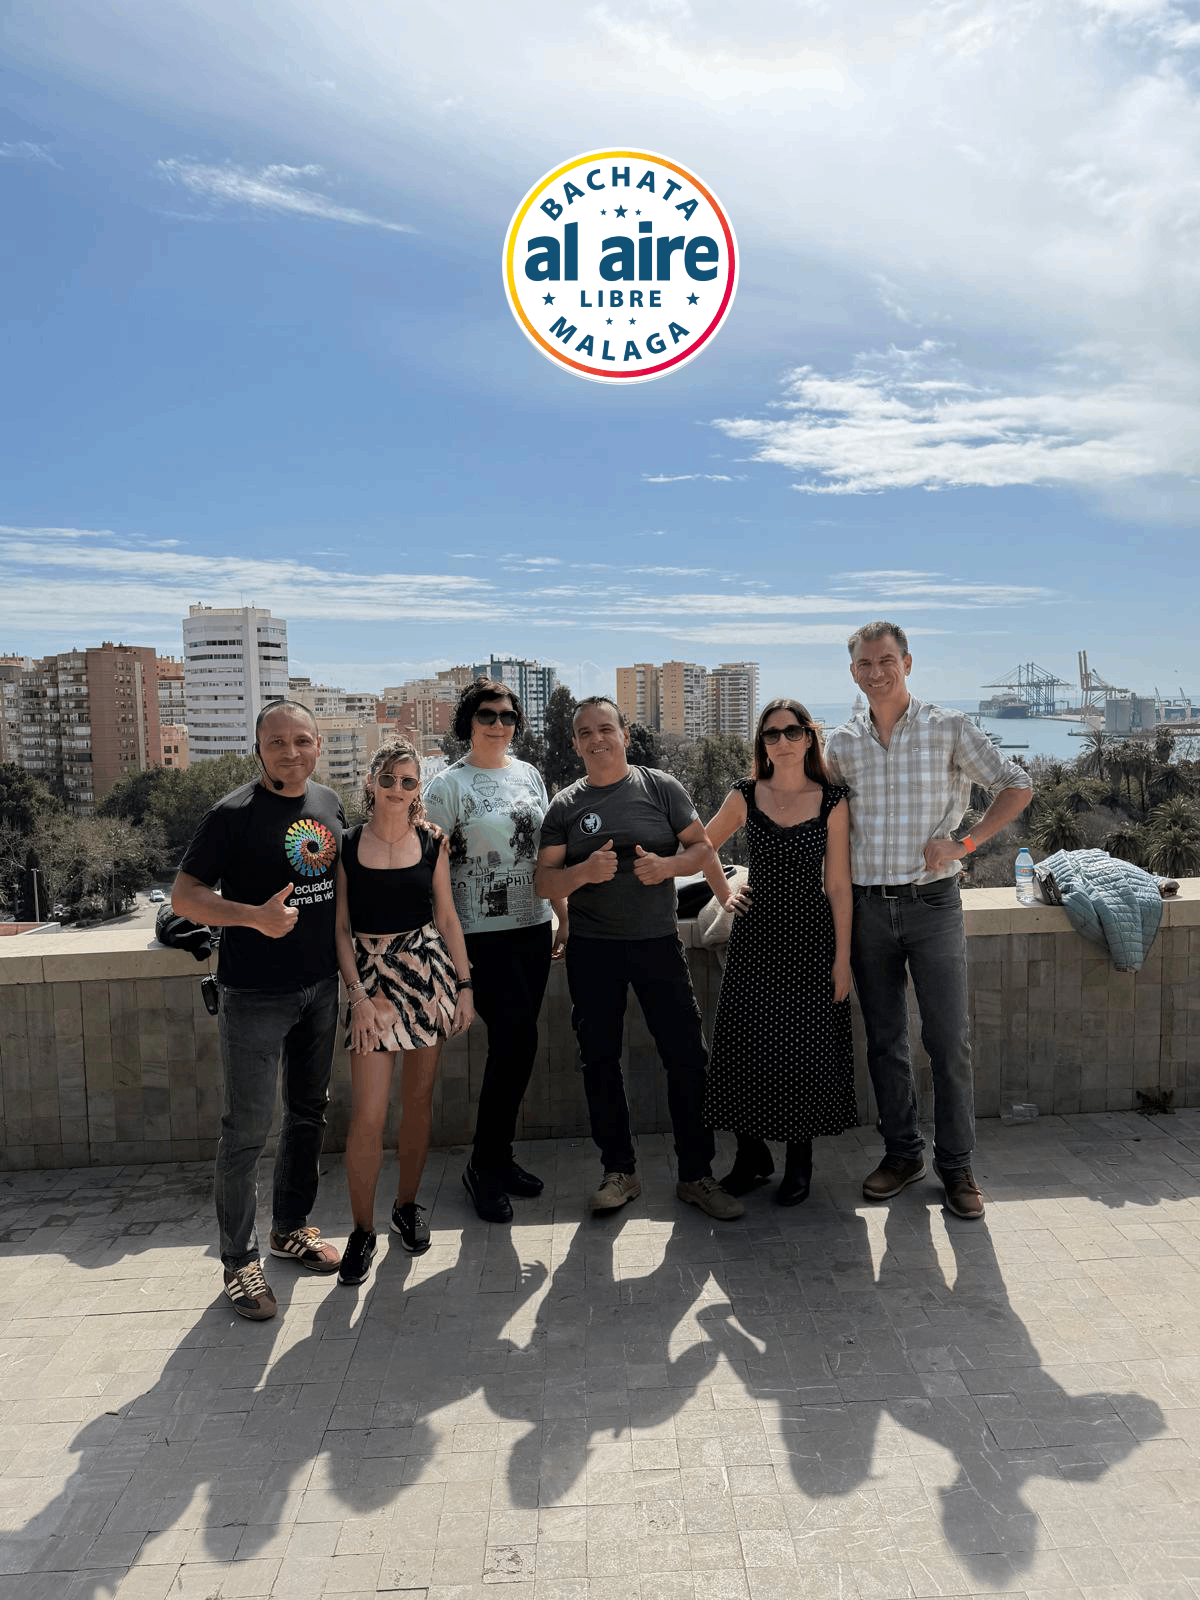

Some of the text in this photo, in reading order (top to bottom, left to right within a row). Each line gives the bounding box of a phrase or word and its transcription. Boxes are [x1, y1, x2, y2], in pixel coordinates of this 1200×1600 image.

[294, 878, 333, 895] ecuador
[289, 889, 334, 906] ama la vid
